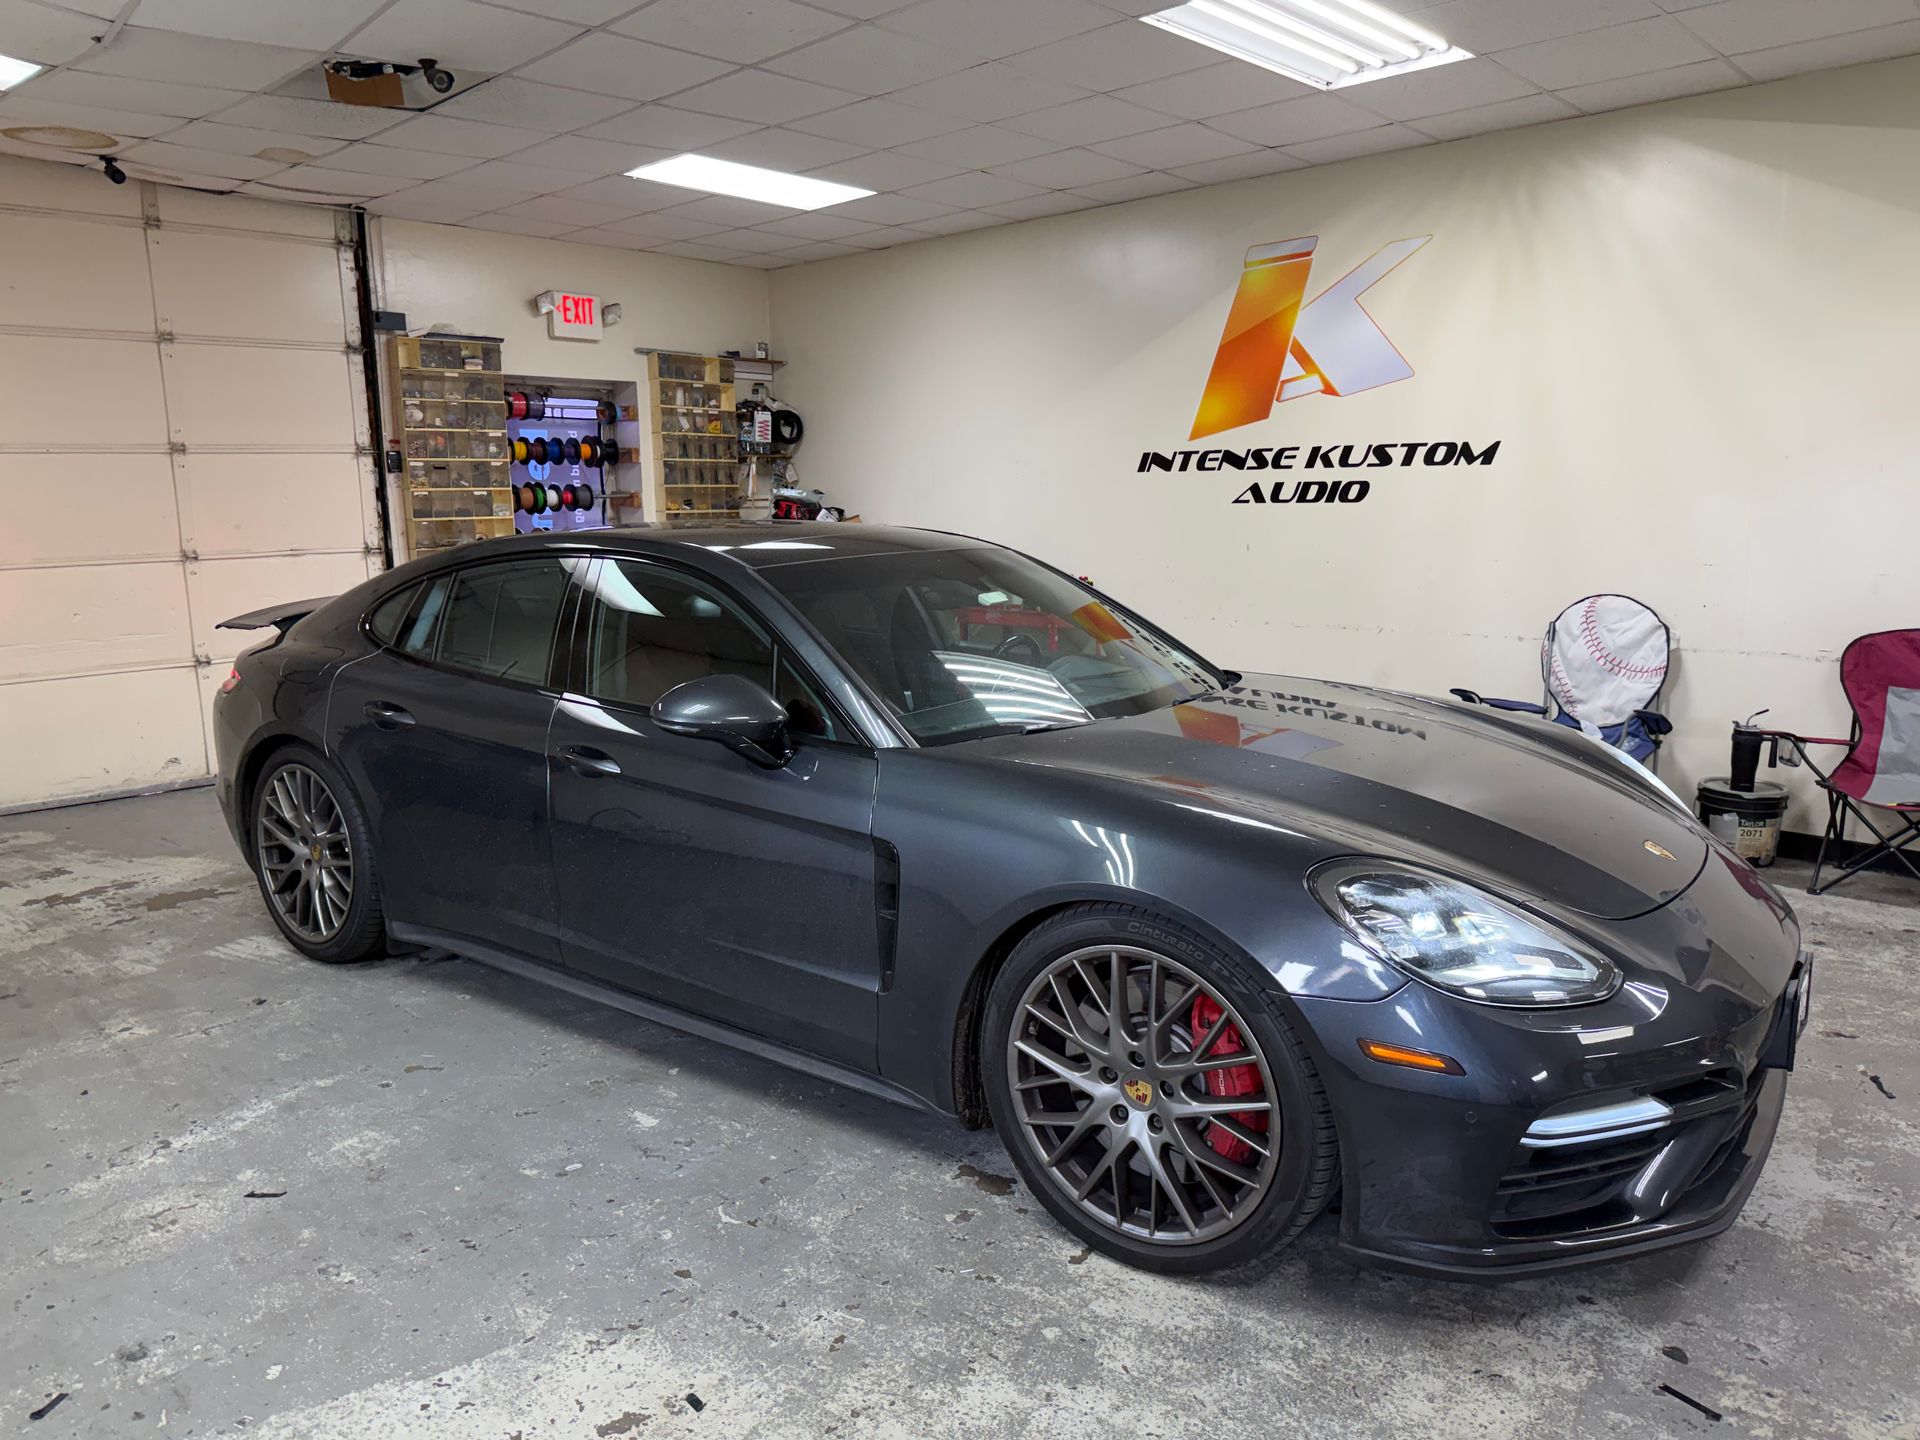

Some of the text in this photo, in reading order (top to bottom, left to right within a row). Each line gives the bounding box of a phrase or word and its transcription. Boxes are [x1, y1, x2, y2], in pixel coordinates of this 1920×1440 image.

[562, 295, 593, 325] EXIT
[1137, 440, 1501, 473] INTENSE KUSTOM
[1231, 480, 1370, 504] AUDIO
[1740, 829, 1762, 838] 2071
